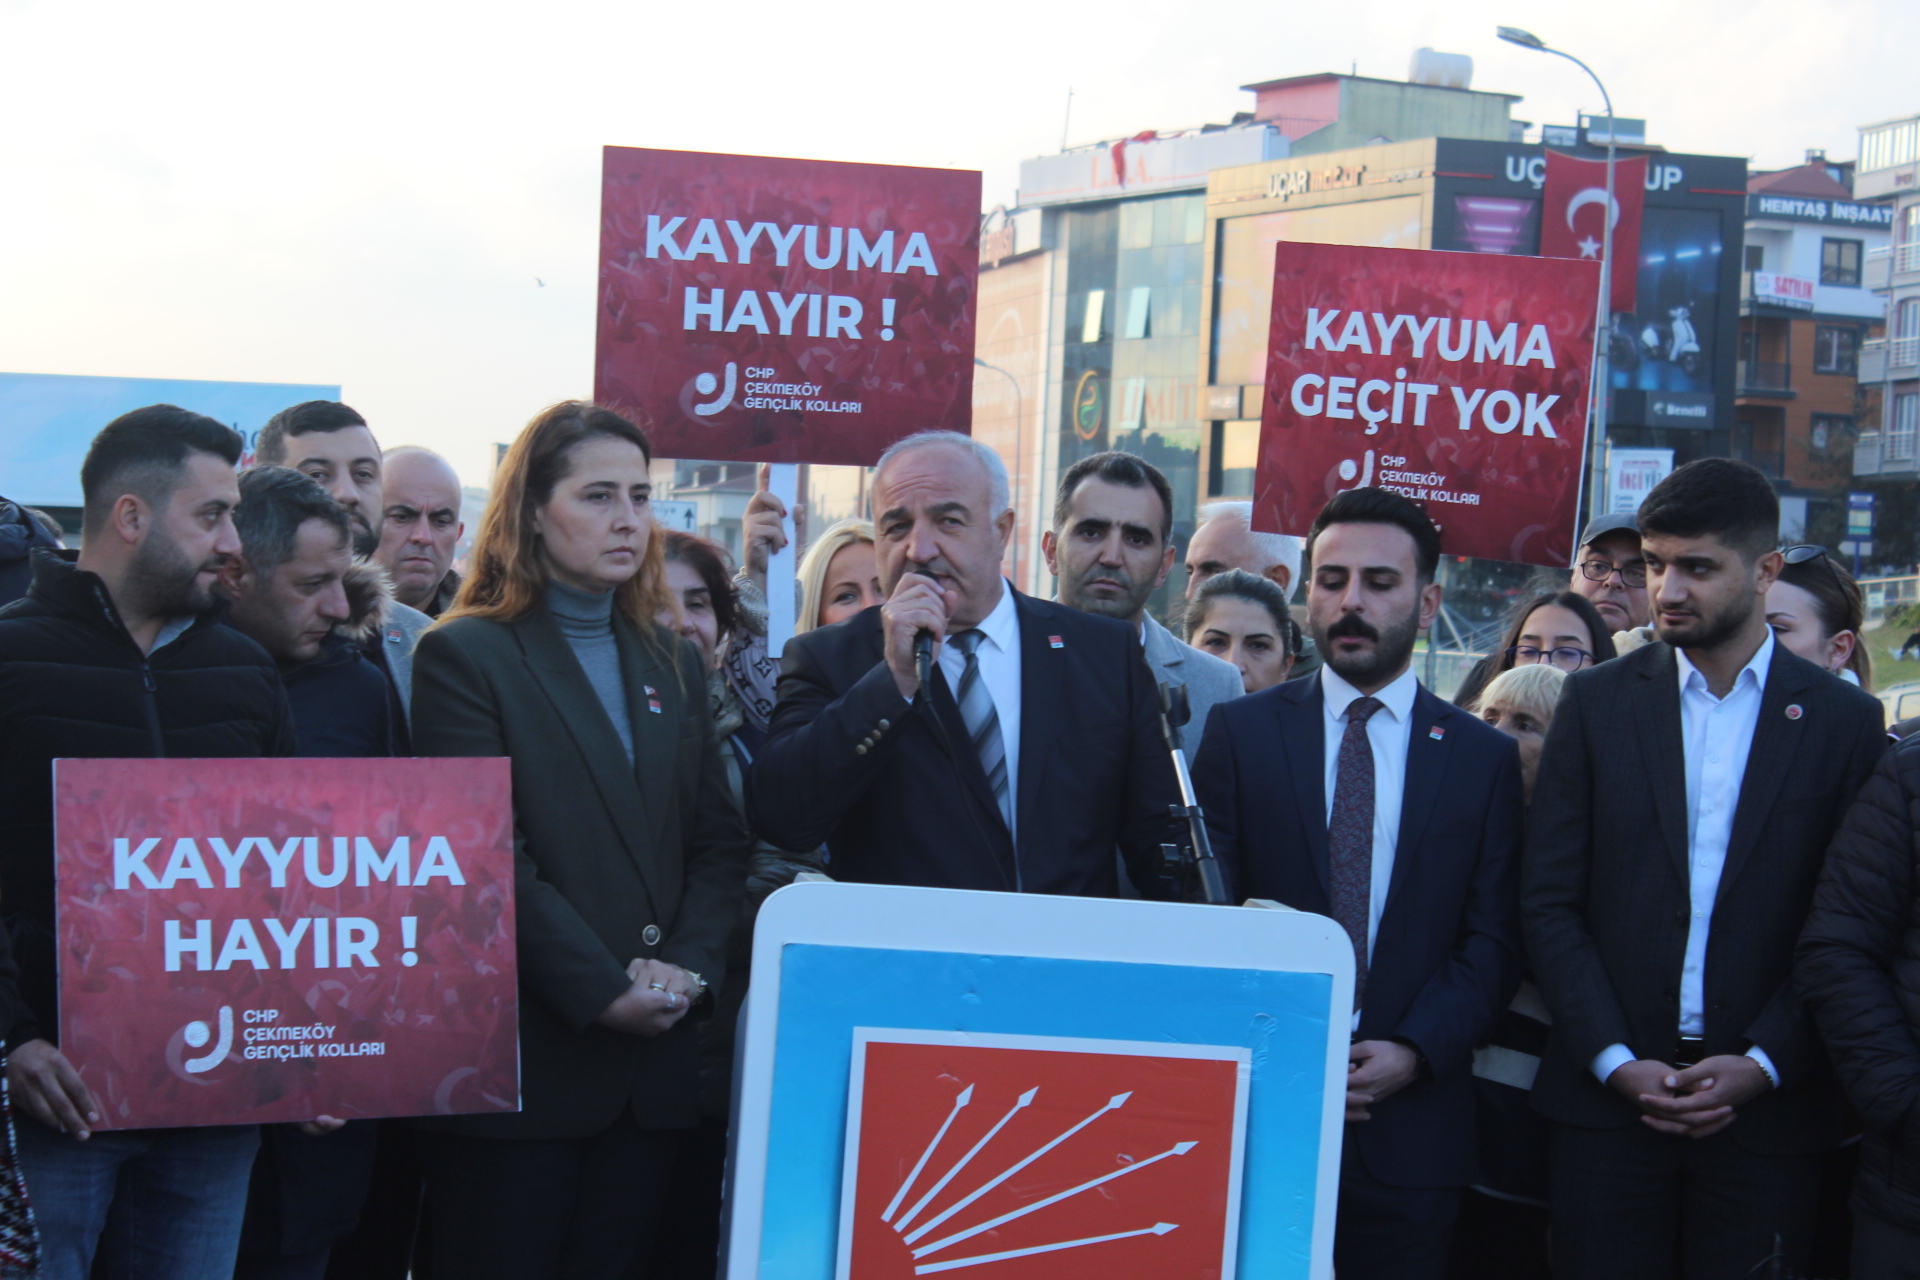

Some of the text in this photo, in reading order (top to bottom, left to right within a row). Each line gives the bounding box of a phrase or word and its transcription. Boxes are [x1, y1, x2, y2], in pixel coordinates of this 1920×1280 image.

[1505, 155, 1546, 189] UÇ
[1268, 169, 1310, 201] UÇAR
[1759, 196, 1894, 224] HEMTAŞ İNŞAAT
[645, 214, 939, 276] KAYYUMA
[683, 286, 896, 342] HAYIR !
[1304, 307, 1556, 369] KAYYUMA
[745, 366, 775, 379] CHP
[744, 381, 822, 397] ÇEKMEKÖY
[743, 396, 862, 414] GENÇLİK KOLLARI
[1290, 367, 1561, 439] GEÇİT YOK
[1380, 455, 1406, 468] CHP
[1379, 470, 1446, 487] ÇEKMEKÖY
[1430, 489, 1480, 506] KOLLARI
[113, 835, 467, 890] KAYYUMA
[164, 915, 419, 972] HAYIR !
[242, 1009, 279, 1024] CHP
[243, 1022, 336, 1045] ÇEKMEKÖY
[243, 1041, 386, 1062] GENÇLİK KOLLARI
